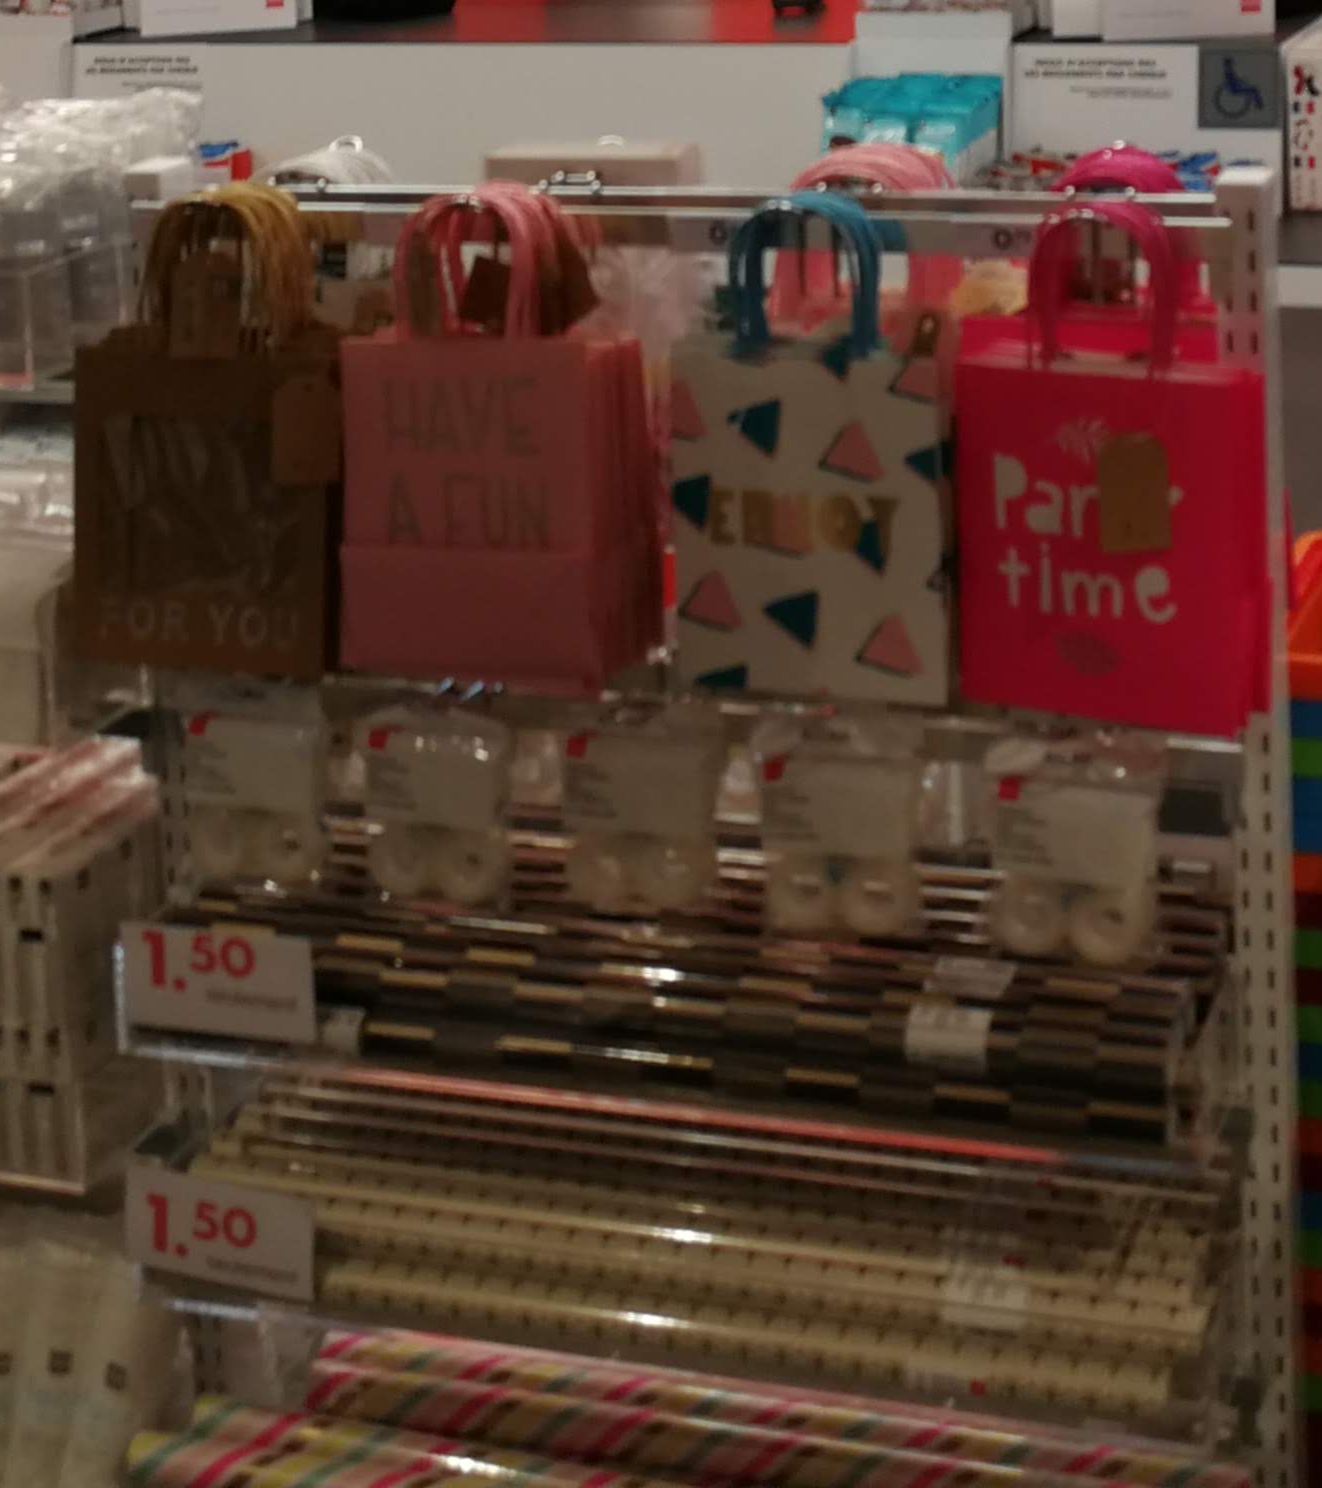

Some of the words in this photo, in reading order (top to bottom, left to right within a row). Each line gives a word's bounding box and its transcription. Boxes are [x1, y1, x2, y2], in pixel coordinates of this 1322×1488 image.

[382, 374, 541, 459] HAVE
[387, 472, 423, 546] A
[440, 475, 551, 552] FUN
[991, 450, 1185, 540] Par
[996, 540, 1179, 625] time
[100, 596, 190, 643] FOR
[206, 602, 302, 651] YOU
[142, 928, 257, 992] 1.50
[147, 1193, 258, 1256] 1.50
